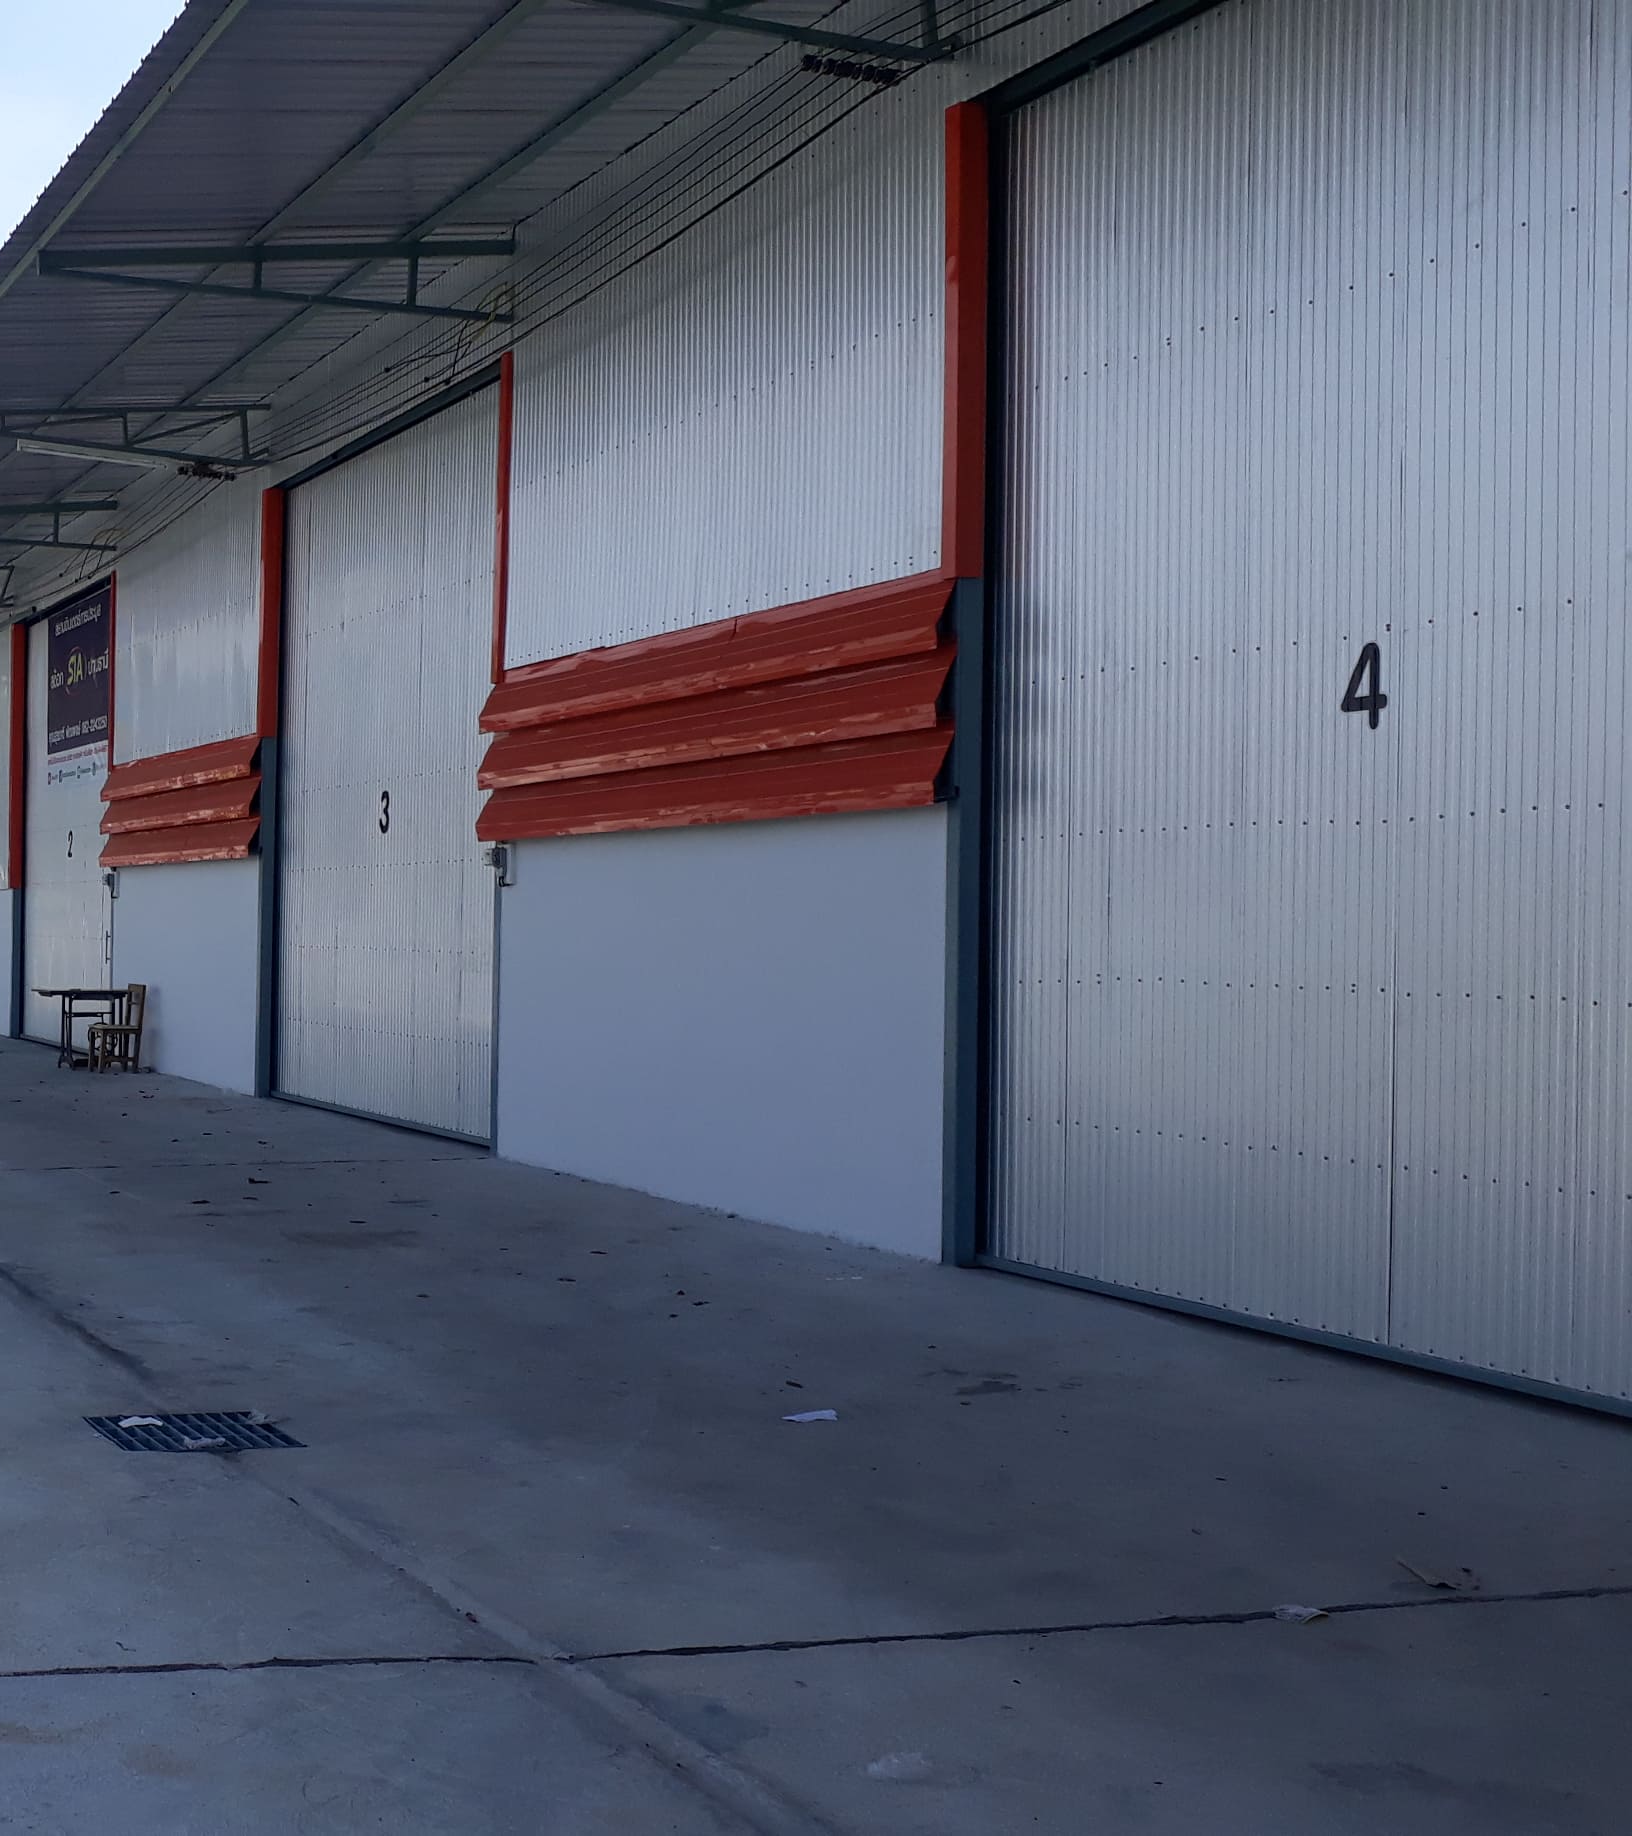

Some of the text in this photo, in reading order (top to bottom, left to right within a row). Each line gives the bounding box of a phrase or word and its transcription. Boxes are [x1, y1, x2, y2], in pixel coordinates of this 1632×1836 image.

[67, 653, 83, 685] SIA
[1341, 642, 1388, 730] 4
[379, 790, 390, 834] 3
[67, 830, 74, 858] 2
